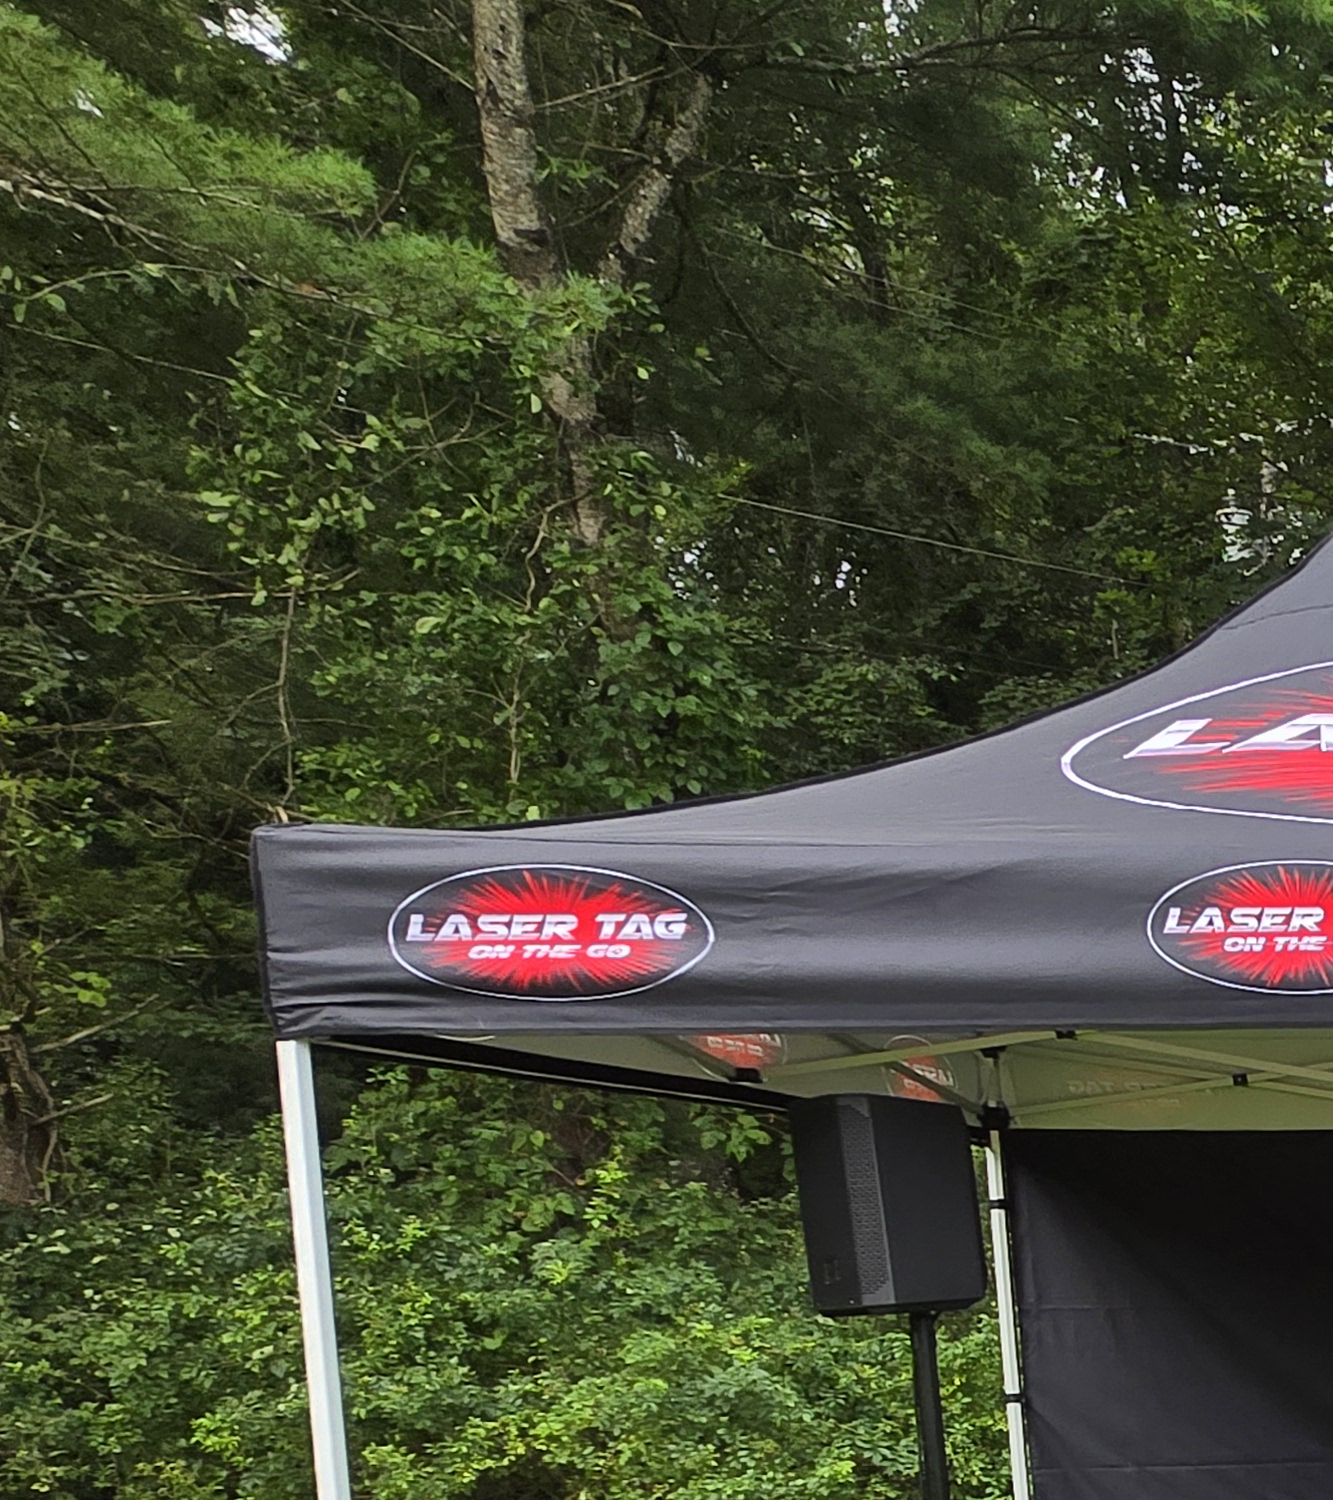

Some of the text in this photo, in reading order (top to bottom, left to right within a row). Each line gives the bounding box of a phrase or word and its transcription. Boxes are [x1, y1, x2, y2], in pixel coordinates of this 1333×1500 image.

[406, 912, 689, 942] LASER TAG
[1164, 907, 1324, 934] LASER
[468, 943, 631, 960] ON THE GO
[1224, 936, 1266, 953] ON
[1273, 935, 1326, 951] THE
